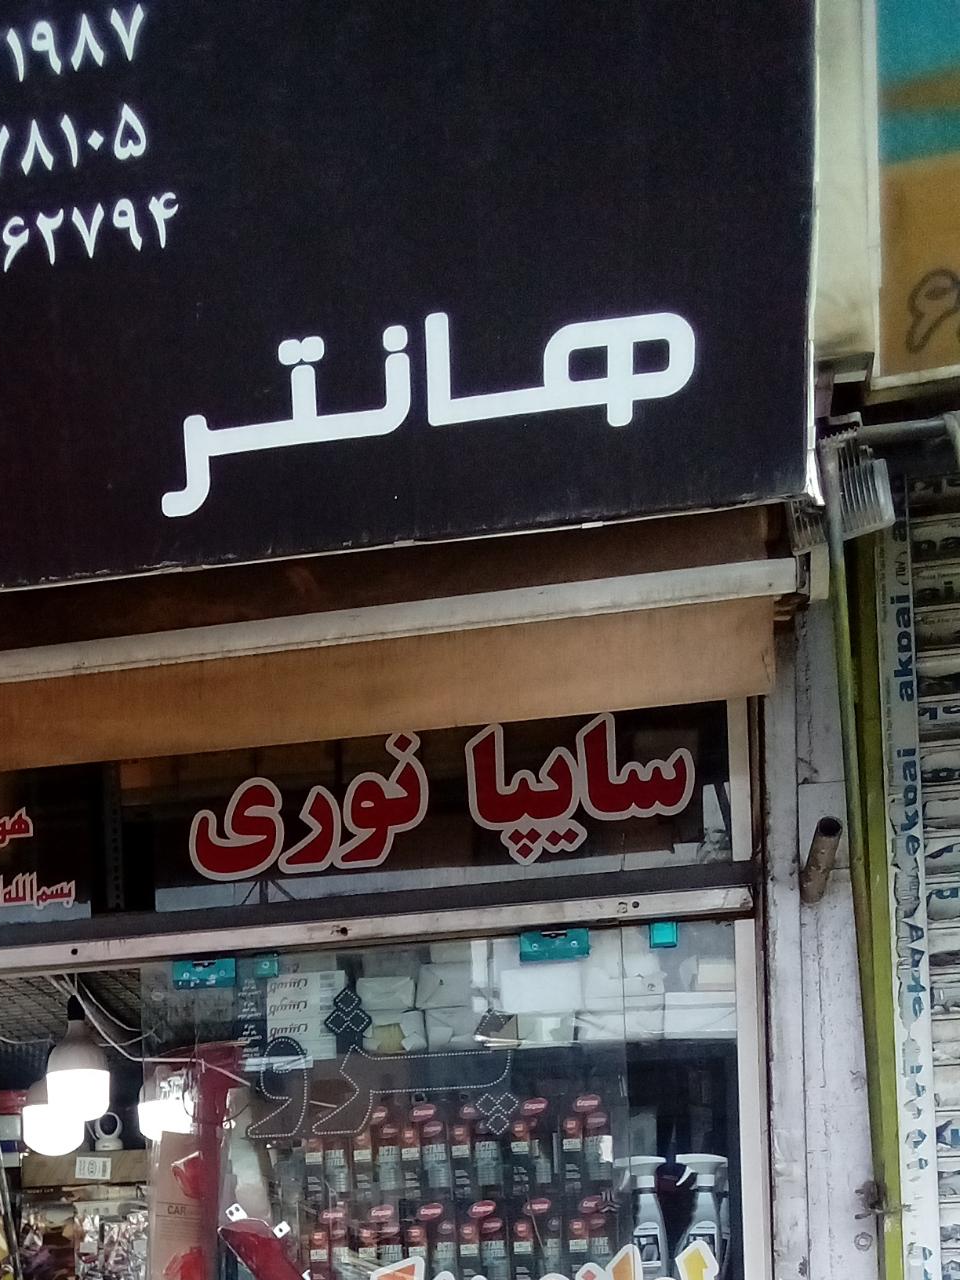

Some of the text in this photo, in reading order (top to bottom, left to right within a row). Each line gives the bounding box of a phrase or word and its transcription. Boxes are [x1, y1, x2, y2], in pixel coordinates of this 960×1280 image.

[162, 312, 695, 517] هانتر
[189, 712, 695, 881] سایپا نوری
